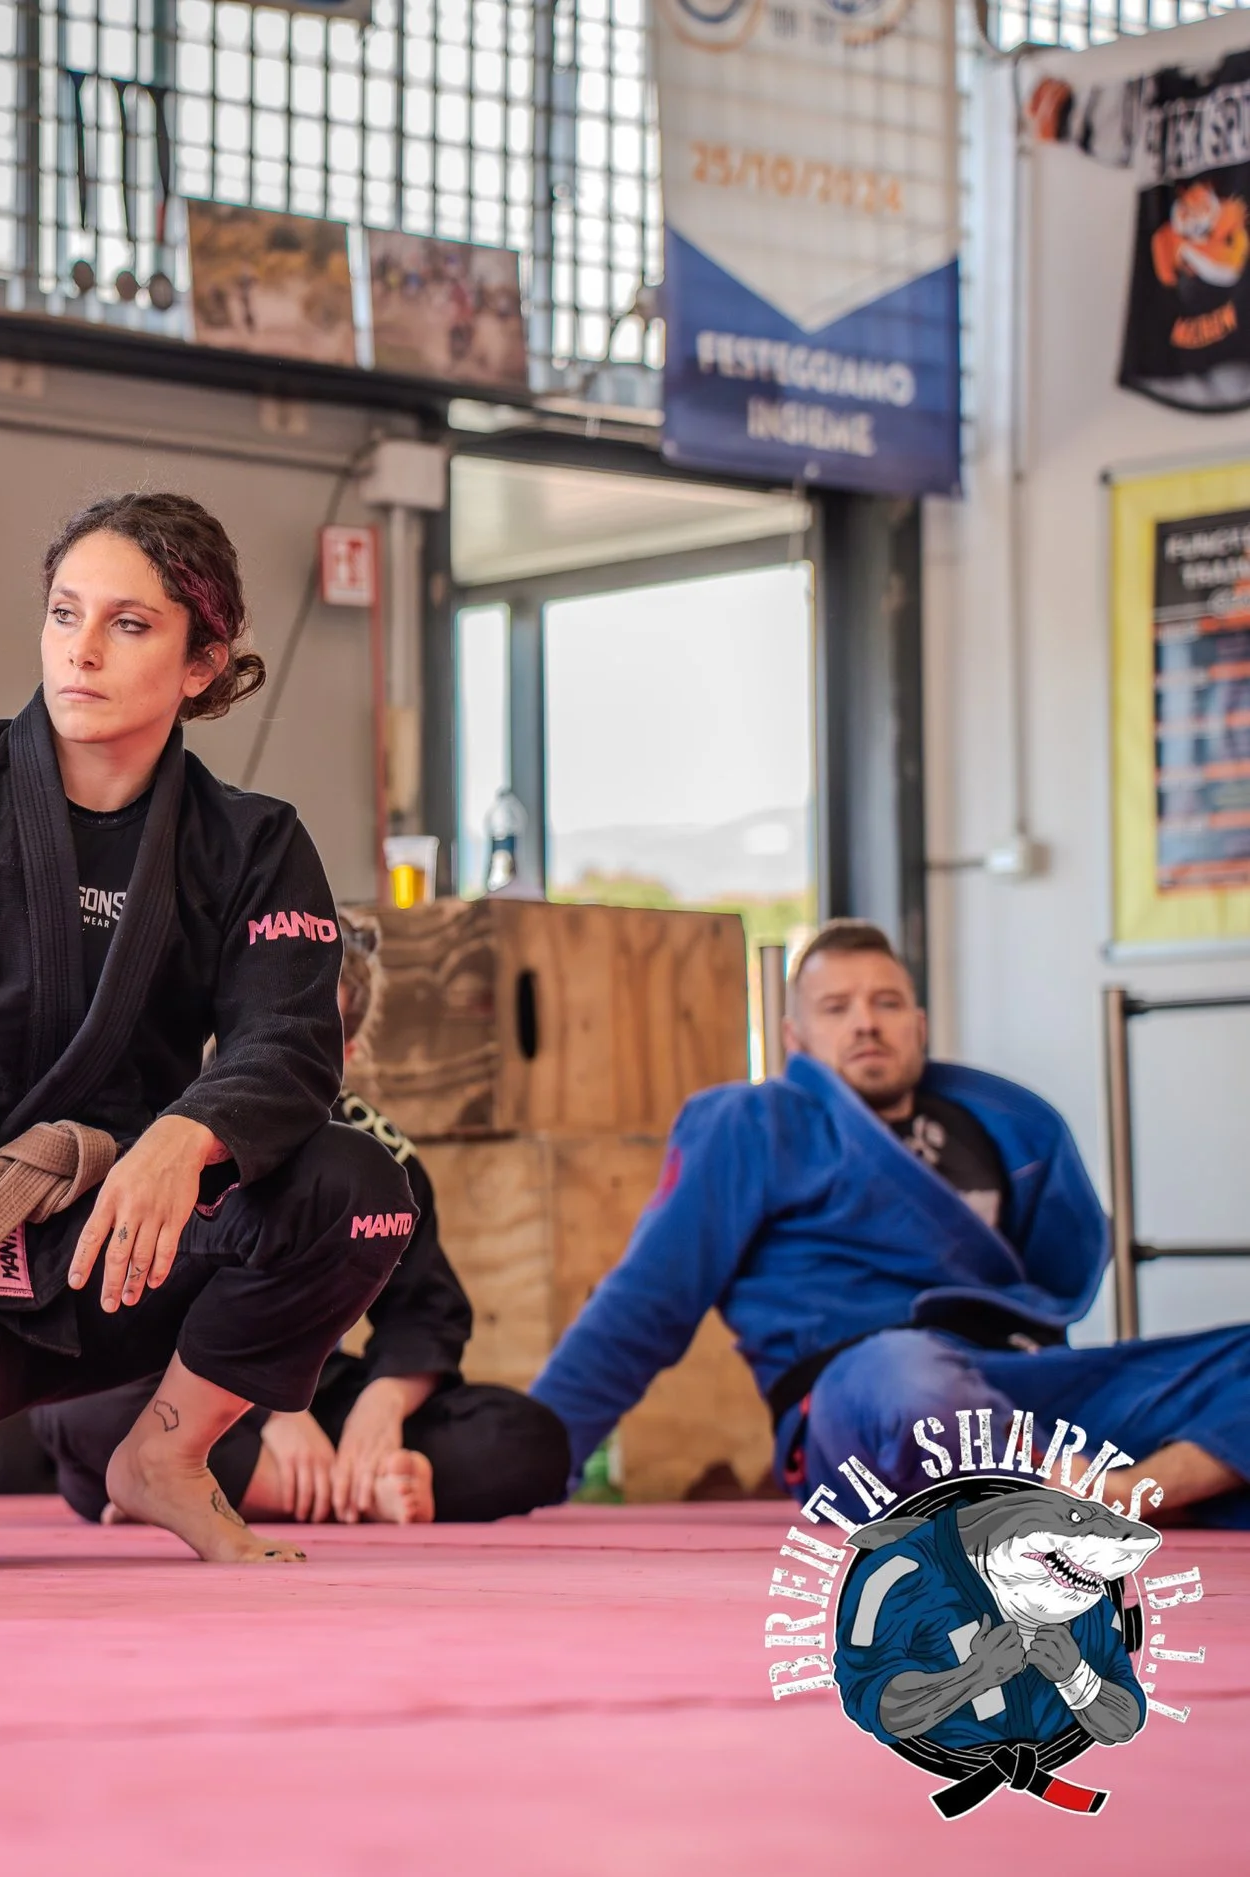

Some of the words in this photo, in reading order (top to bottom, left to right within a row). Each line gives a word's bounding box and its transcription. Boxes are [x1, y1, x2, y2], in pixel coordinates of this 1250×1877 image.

[696, 330, 916, 407] FESTEGGIAMO
[747, 396, 877, 457] INSIEME
[83, 915, 110, 928] WEAR
[248, 911, 338, 945] MANTO
[350, 1213, 412, 1239] MANTO
